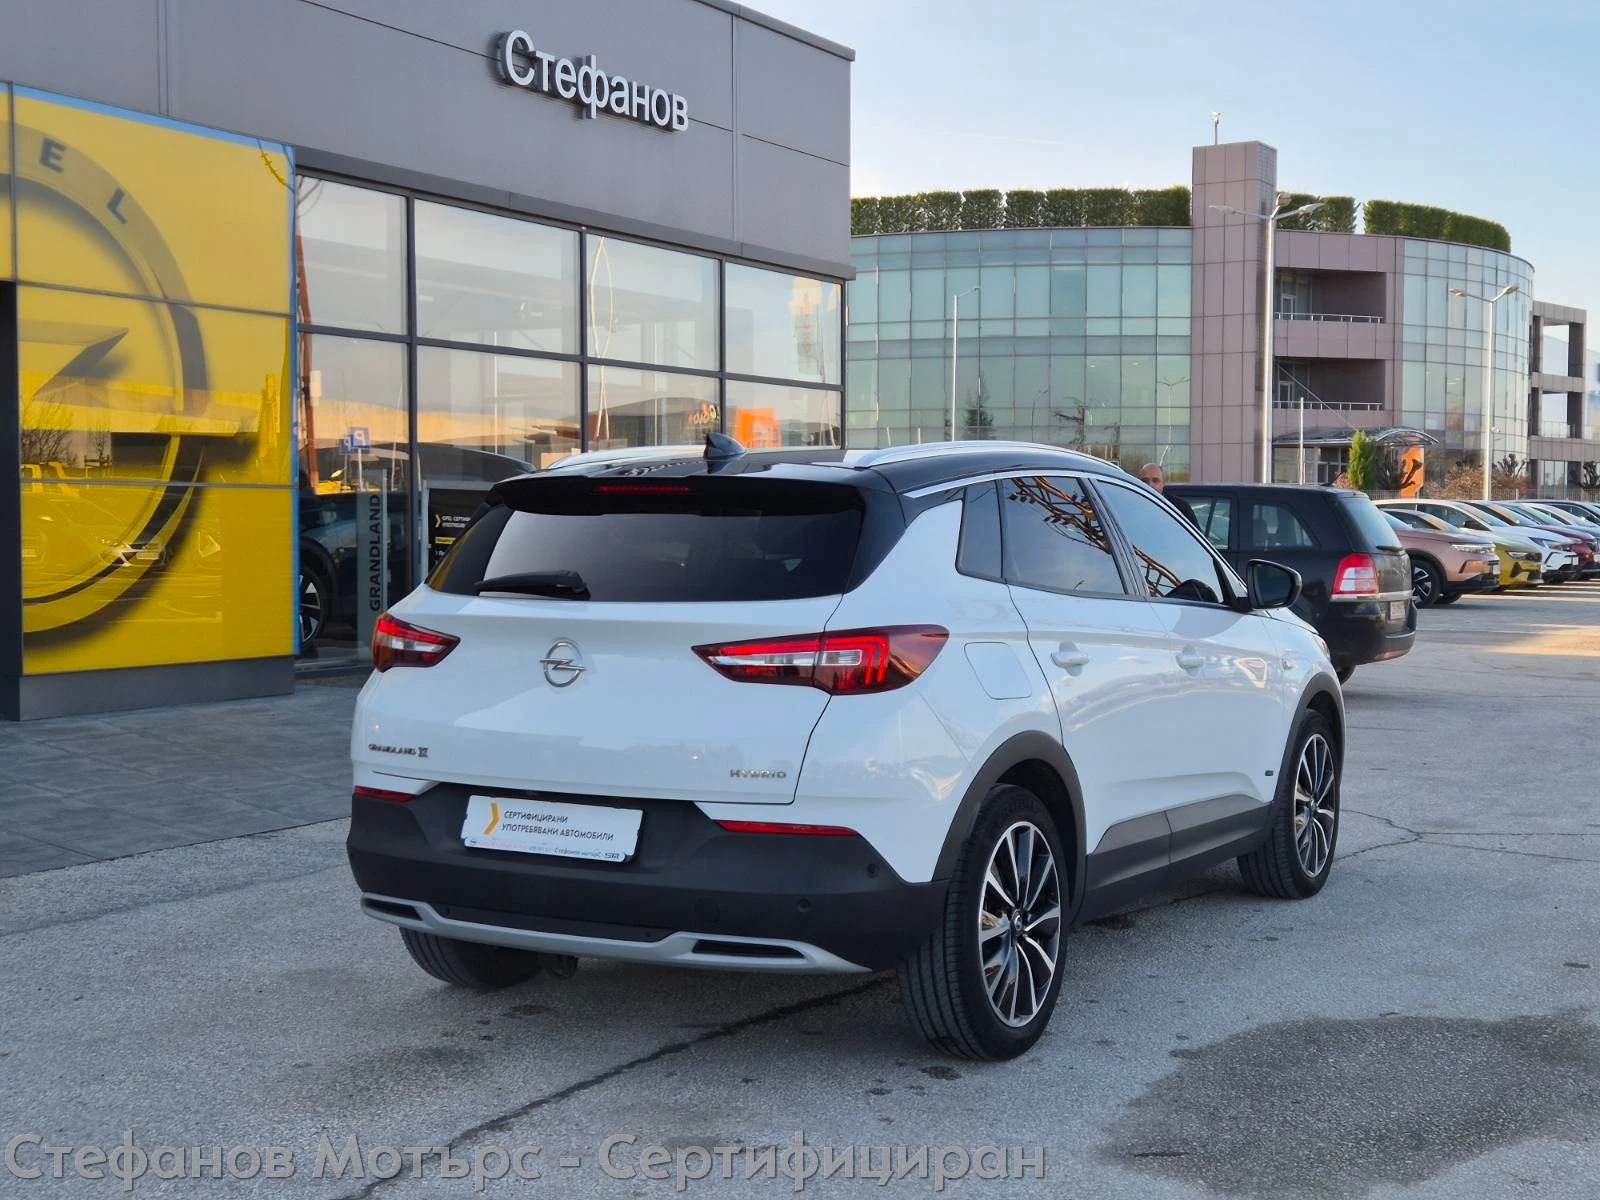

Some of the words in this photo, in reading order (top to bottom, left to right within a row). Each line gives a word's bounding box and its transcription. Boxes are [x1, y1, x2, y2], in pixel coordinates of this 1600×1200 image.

[503, 30, 689, 132] Стефанов
[368, 493, 382, 612] GRANDLAND
[730, 769, 787, 779] HYBRID
[503, 810, 569, 824] СЕРТИФИЦИРАНИ
[502, 824, 560, 836] УПОТРЕБЯВАНИ
[559, 829, 614, 841] АВТОМОБИЛИ
